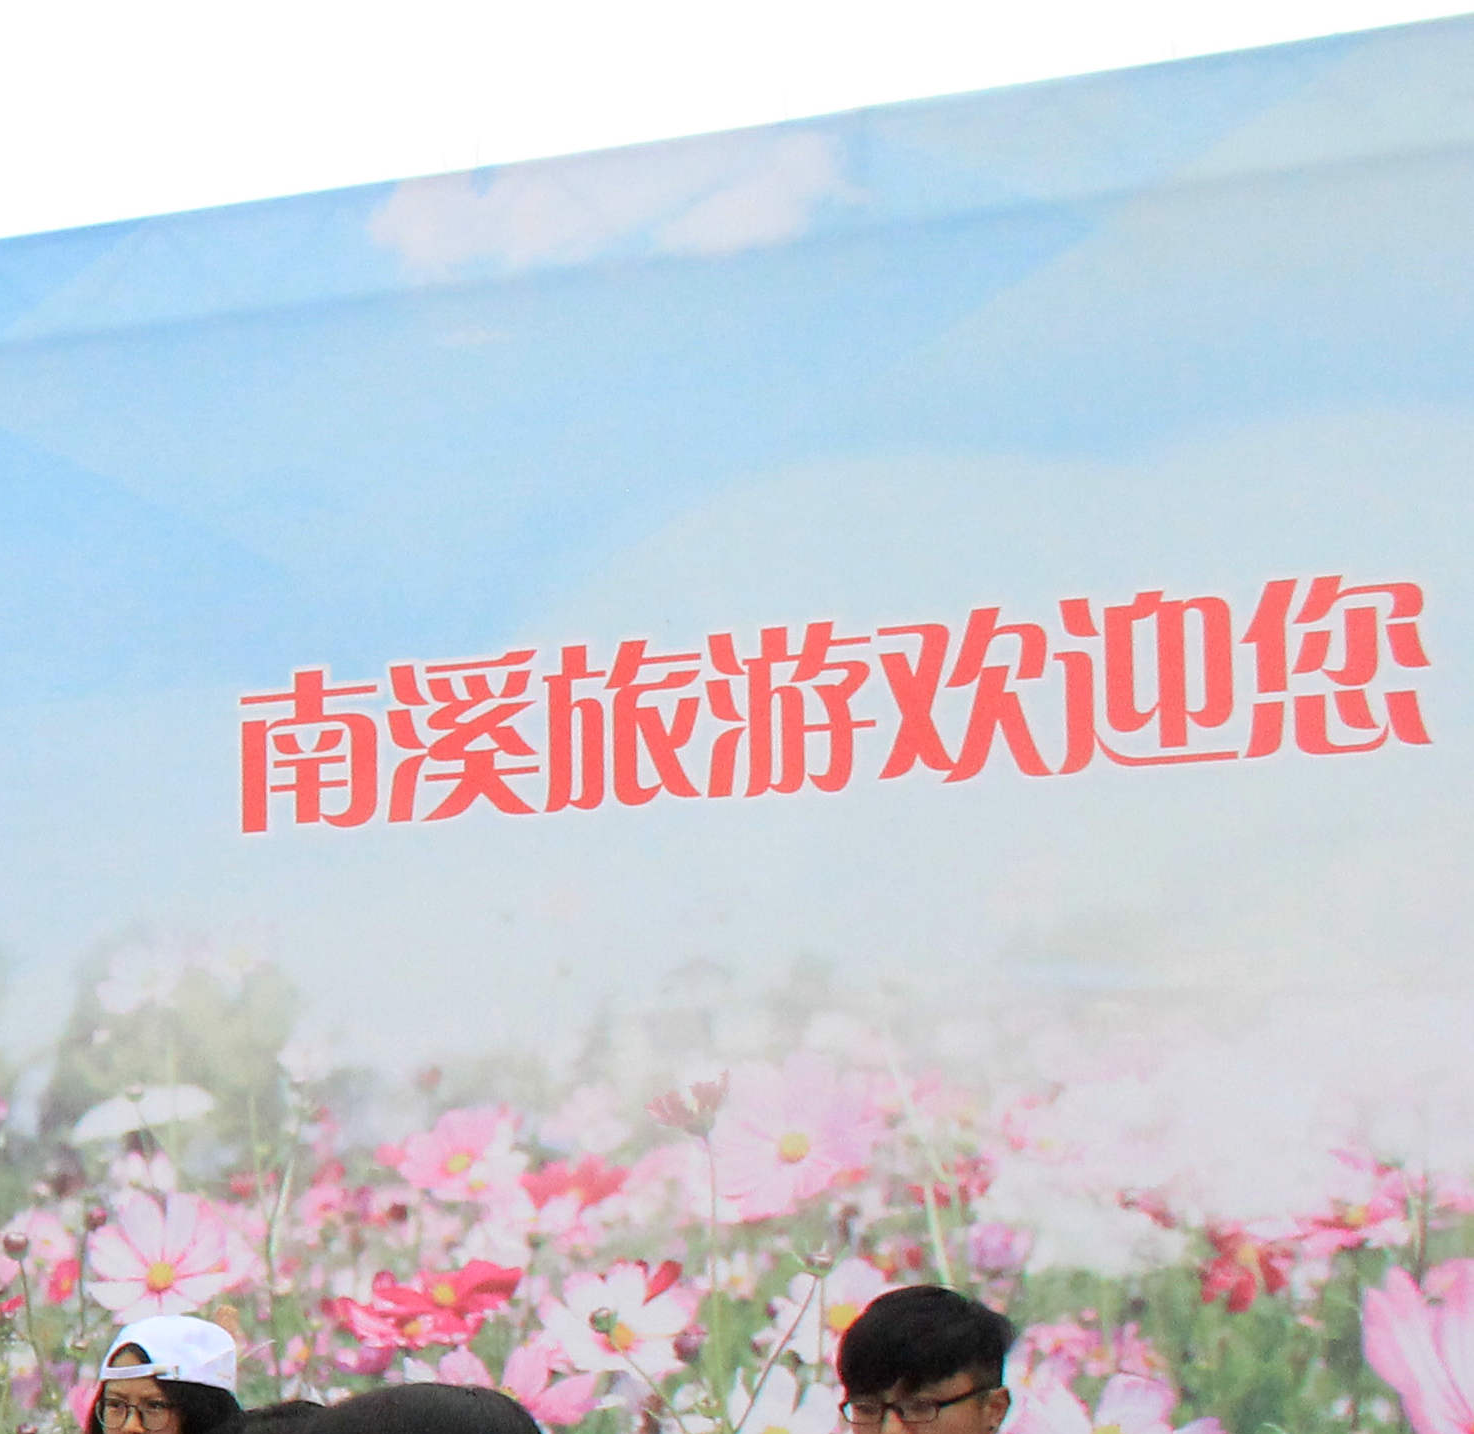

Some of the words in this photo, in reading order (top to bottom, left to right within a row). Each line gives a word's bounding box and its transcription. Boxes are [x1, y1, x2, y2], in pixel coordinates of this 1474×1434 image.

[239, 575, 1434, 834] 南溪旅游欢迎您
